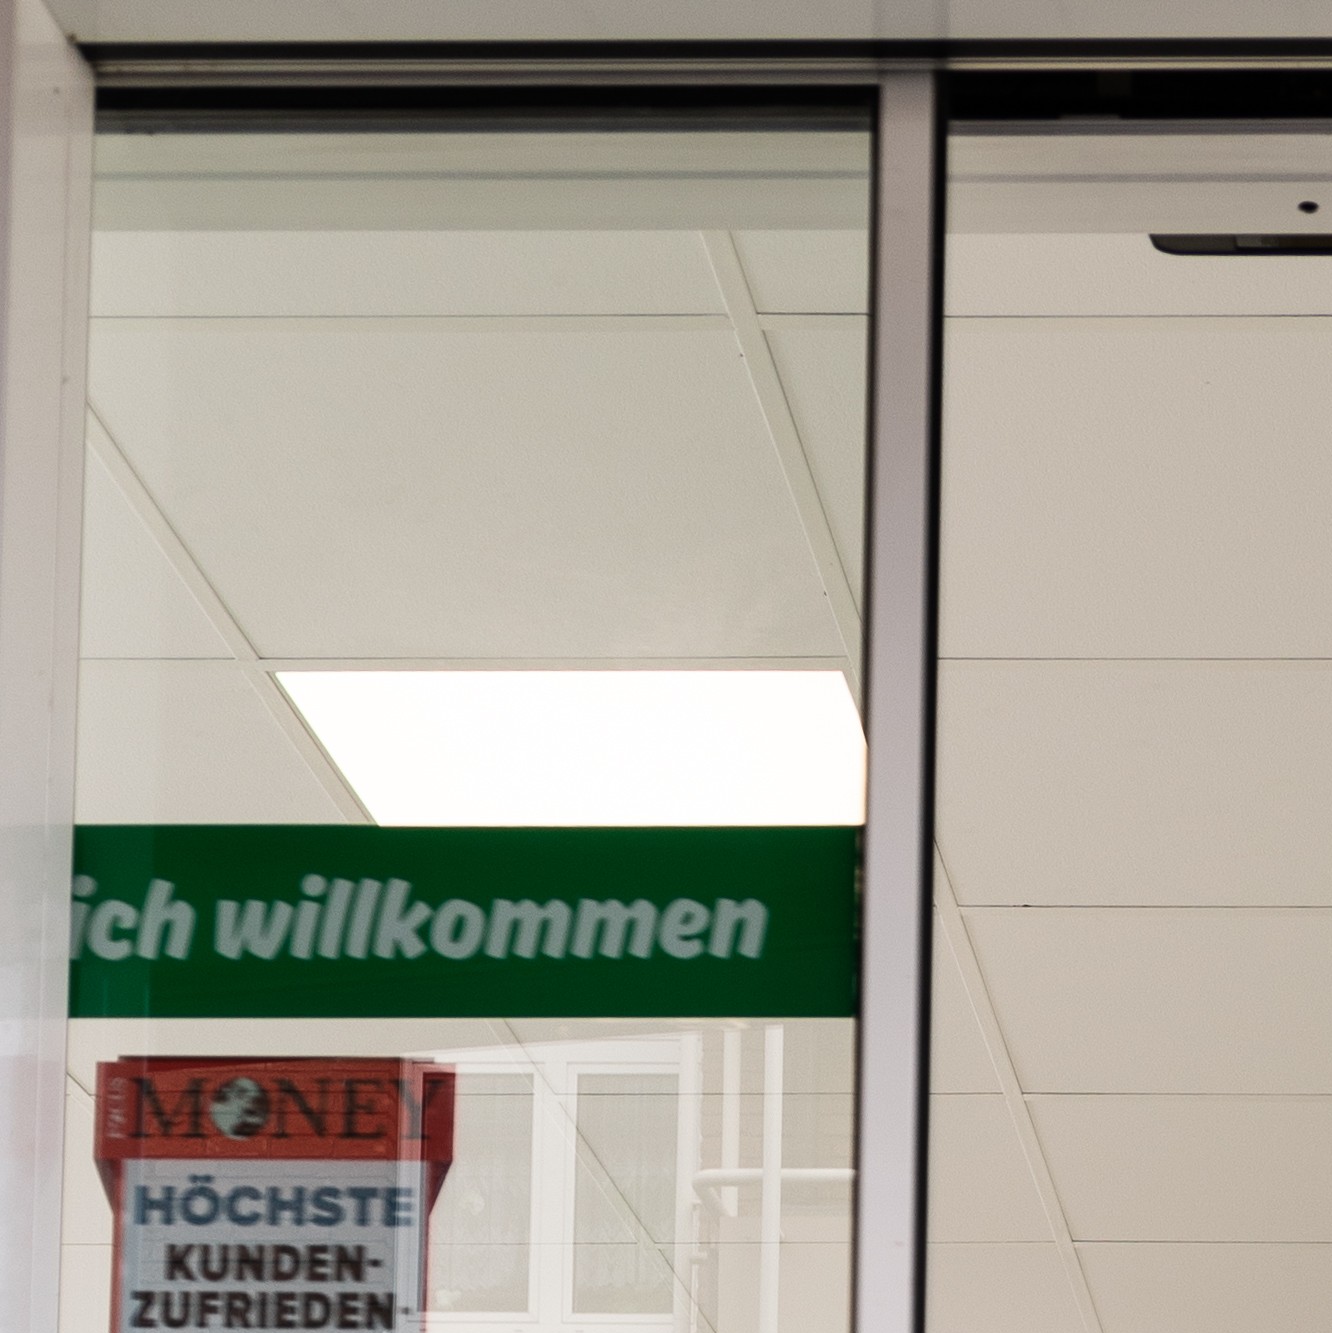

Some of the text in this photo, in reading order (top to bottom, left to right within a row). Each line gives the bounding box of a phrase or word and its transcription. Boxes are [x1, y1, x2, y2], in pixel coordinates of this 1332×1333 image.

[214, 874, 769, 962] willkommen
[127, 1077, 449, 1140] MONEY
[133, 1173, 415, 1228] HÖCHSTE
[164, 1243, 384, 1283] KUNDEN-
[130, 1290, 410, 1331] ZUFRIEDEN-
